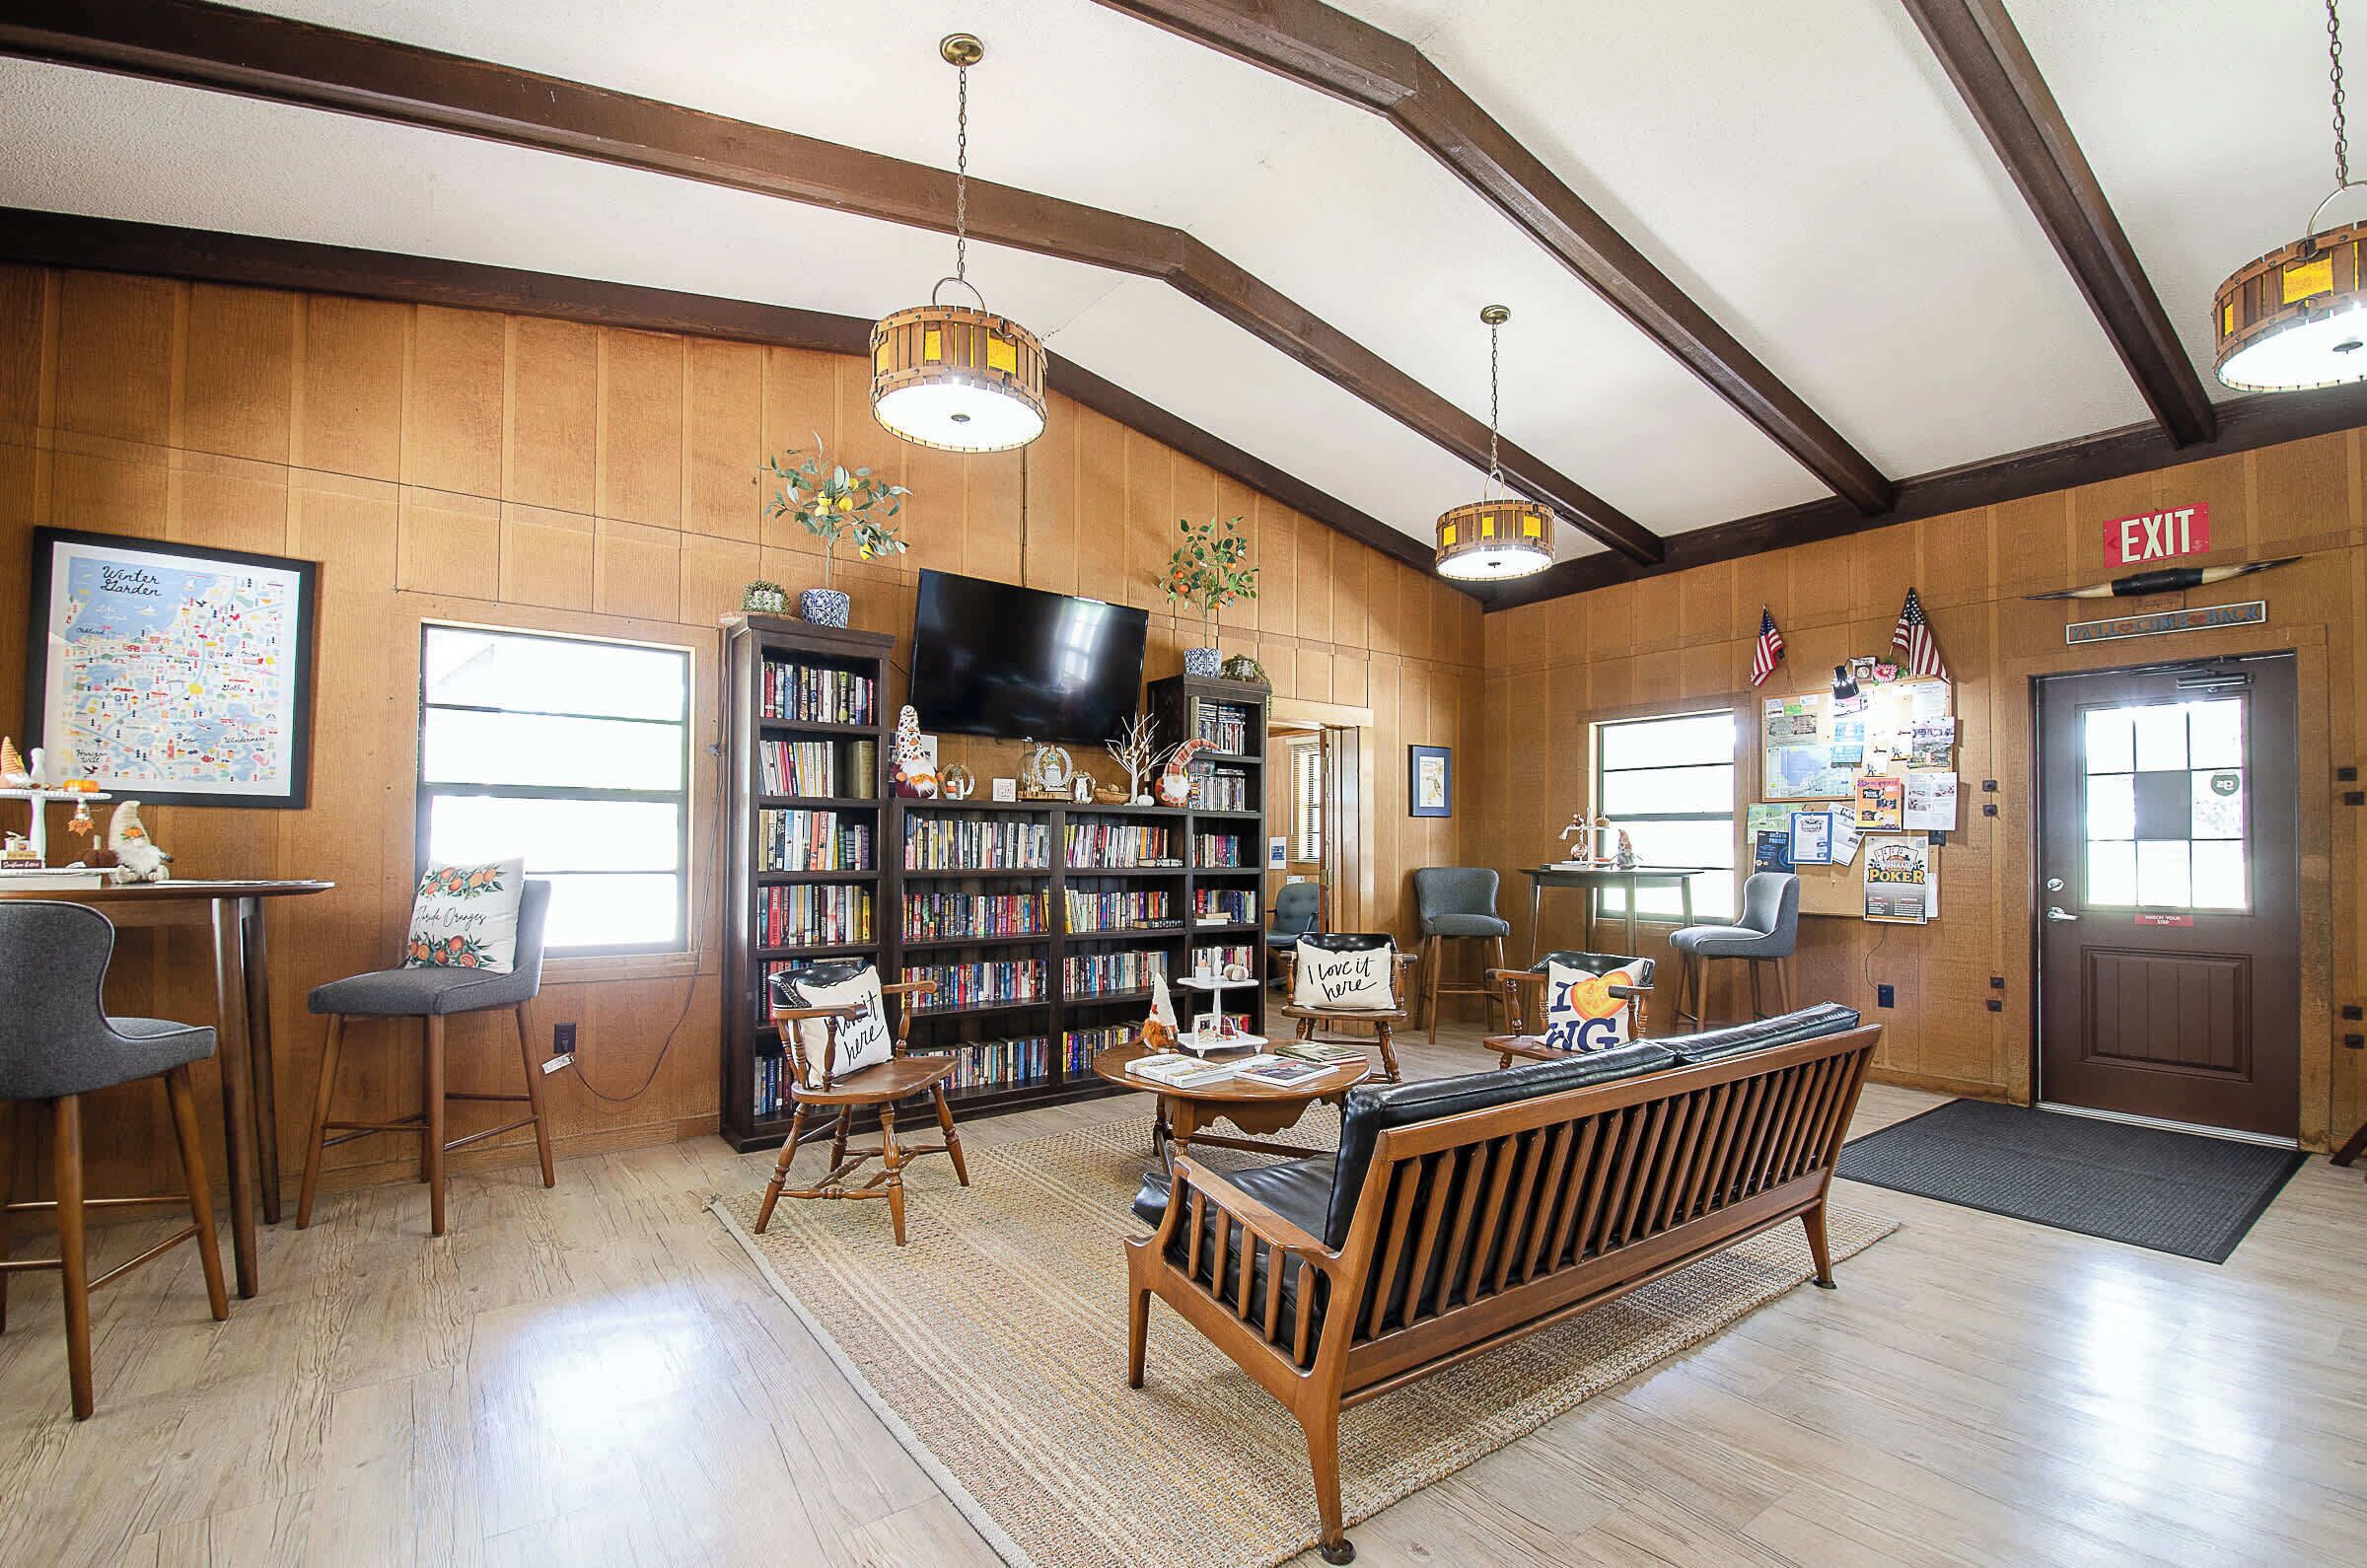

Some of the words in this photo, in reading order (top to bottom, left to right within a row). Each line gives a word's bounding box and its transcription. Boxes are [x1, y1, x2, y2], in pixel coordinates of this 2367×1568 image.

[2121, 509, 2194, 563] EXIT
[100, 578, 162, 596] Garden
[102, 565, 160, 584] Winter
[2133, 612, 2188, 633] COME
[2206, 606, 2259, 625] BACK
[1869, 868, 1925, 884] POKER
[443, 906, 487, 932] Oranges
[1308, 965, 1314, 985] I
[1356, 956, 1376, 977] it
[1322, 978, 1378, 1003] here
[843, 1025, 885, 1067] here
